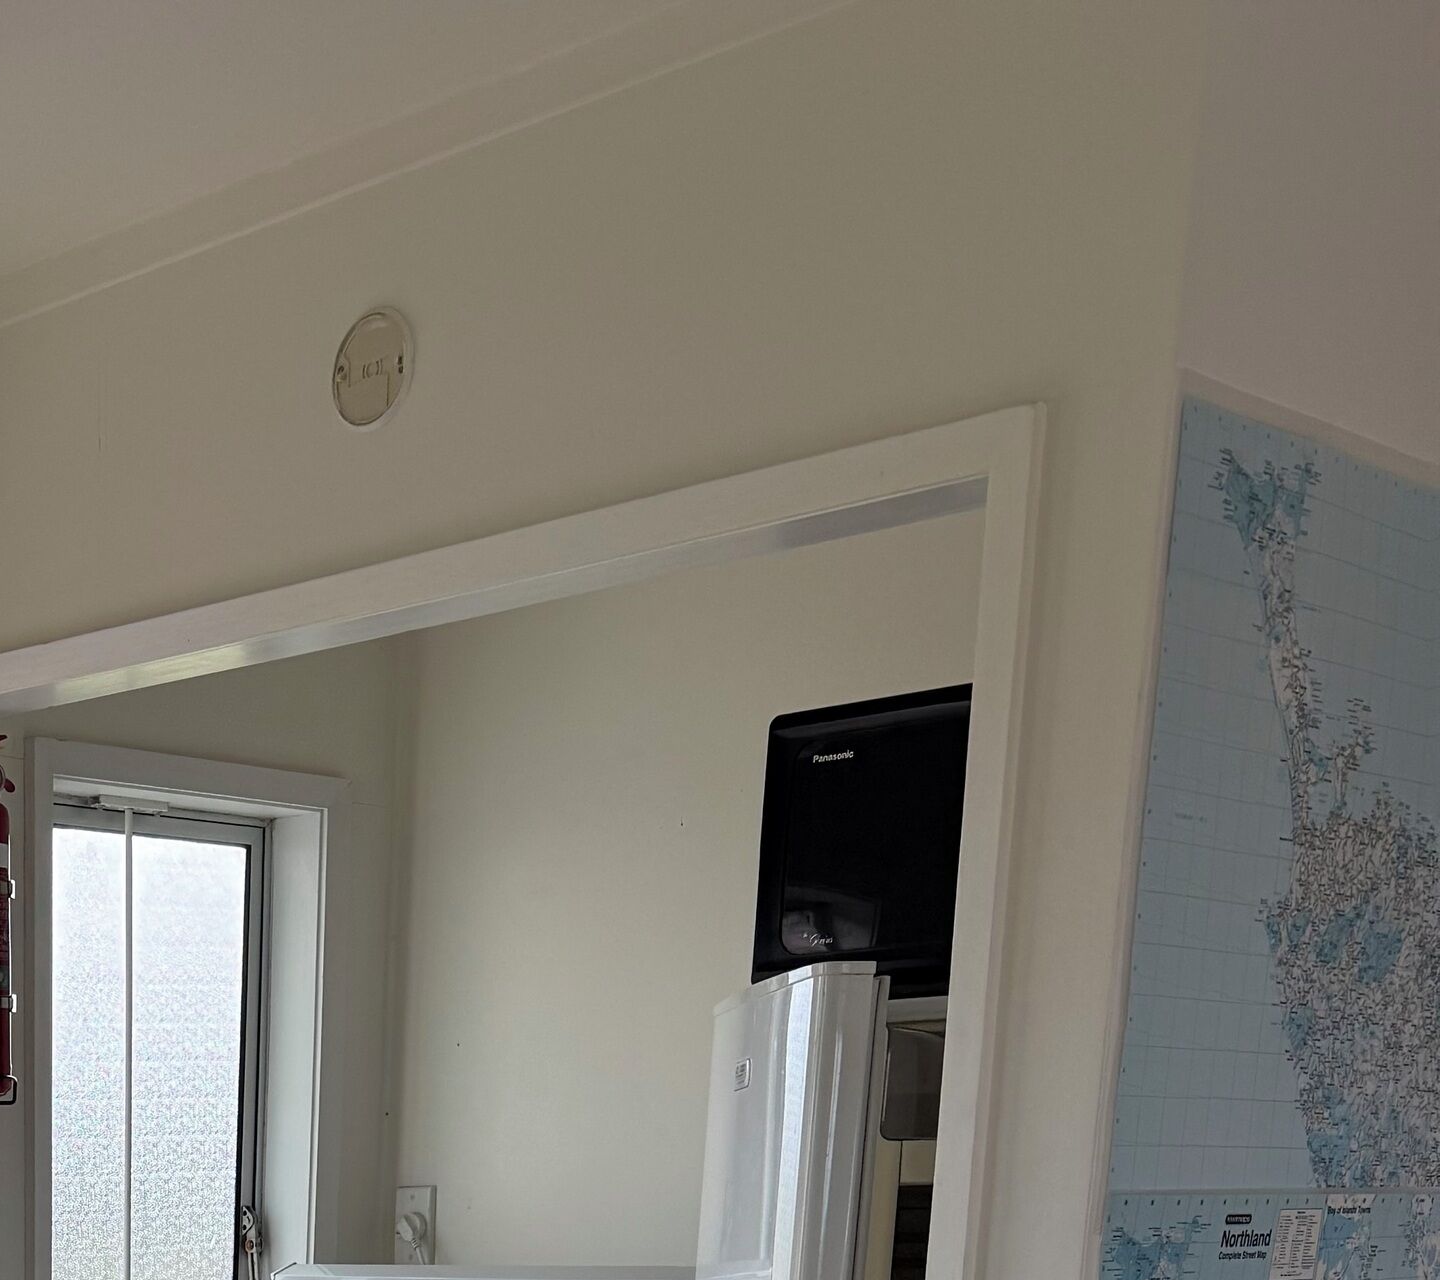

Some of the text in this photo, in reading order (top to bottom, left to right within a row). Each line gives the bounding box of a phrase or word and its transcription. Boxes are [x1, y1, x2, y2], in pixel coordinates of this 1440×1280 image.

[813, 749, 854, 763] Panasonic
[1220, 1229, 1272, 1248] Northland
[1218, 1250, 1267, 1260] Complete Street Map
